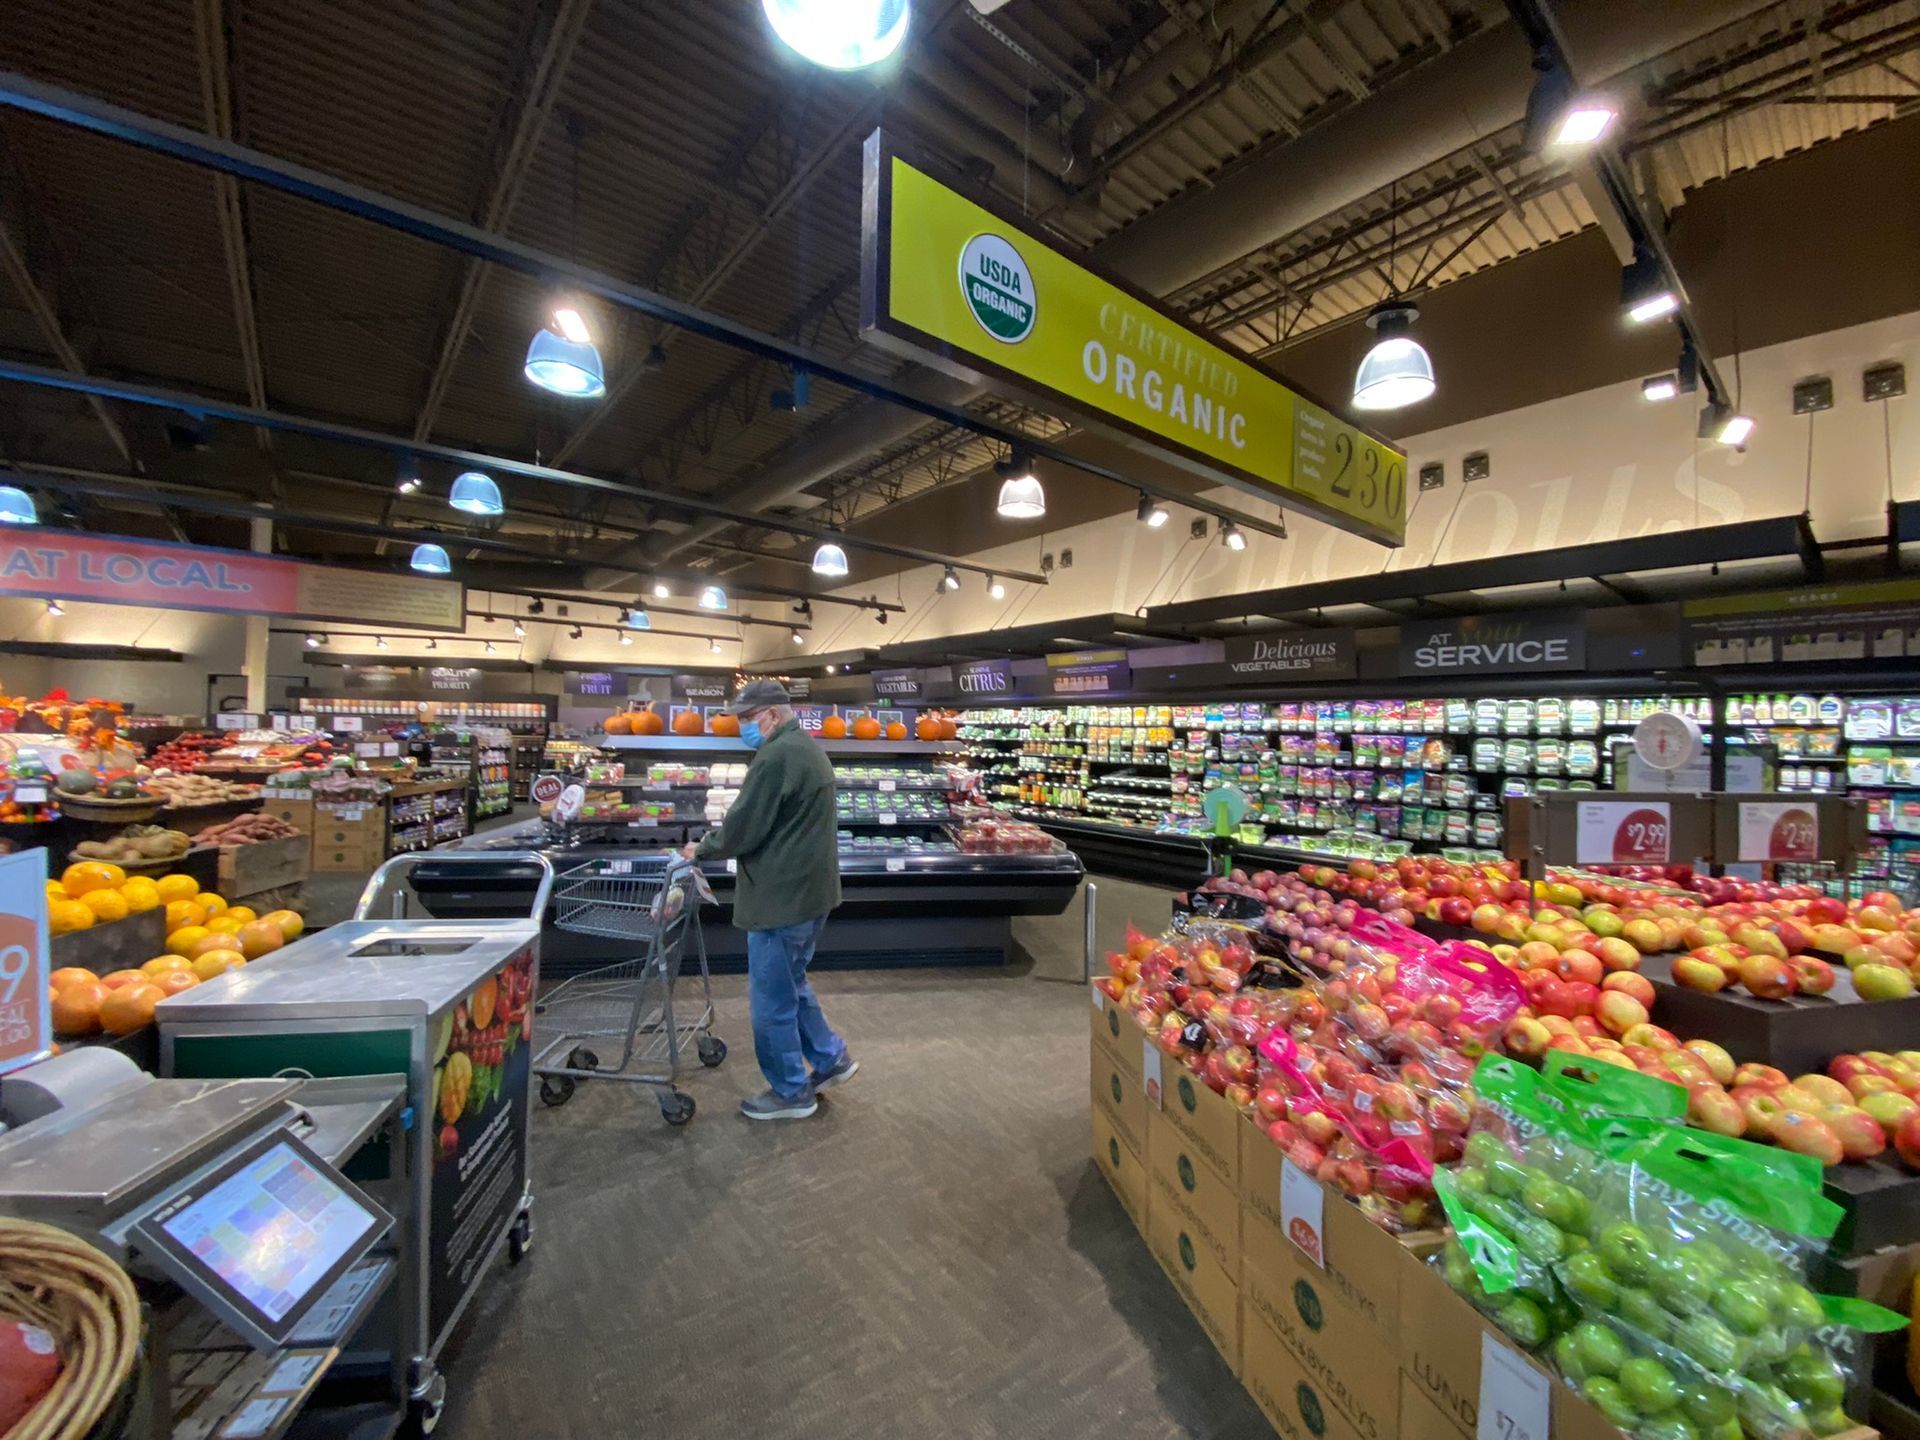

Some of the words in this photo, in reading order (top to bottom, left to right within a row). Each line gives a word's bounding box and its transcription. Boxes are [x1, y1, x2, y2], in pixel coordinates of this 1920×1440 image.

[979, 252, 1023, 295] USDA
[972, 285, 1028, 324] ORGANIC
[1099, 301, 1239, 399] CERTIFIED
[1082, 340, 1247, 449] ORGANIC
[1331, 431, 1404, 521] 230
[78, 552, 252, 592] LOCAL.
[1253, 637, 1336, 661] Delicious
[1414, 638, 1569, 669] SERVICE
[1427, 633, 1453, 647] AT
[1231, 658, 1311, 673] VEGETABLES
[581, 683, 612, 695] FRUIT
[685, 688, 724, 697] SEASON
[875, 680, 918, 694] VEGETABLES
[959, 672, 1006, 693] CITRUS
[801, 709, 823, 719] BEST
[1626, 822, 1666, 851] $2.99
[1698, 1197, 1801, 1272] Smith
